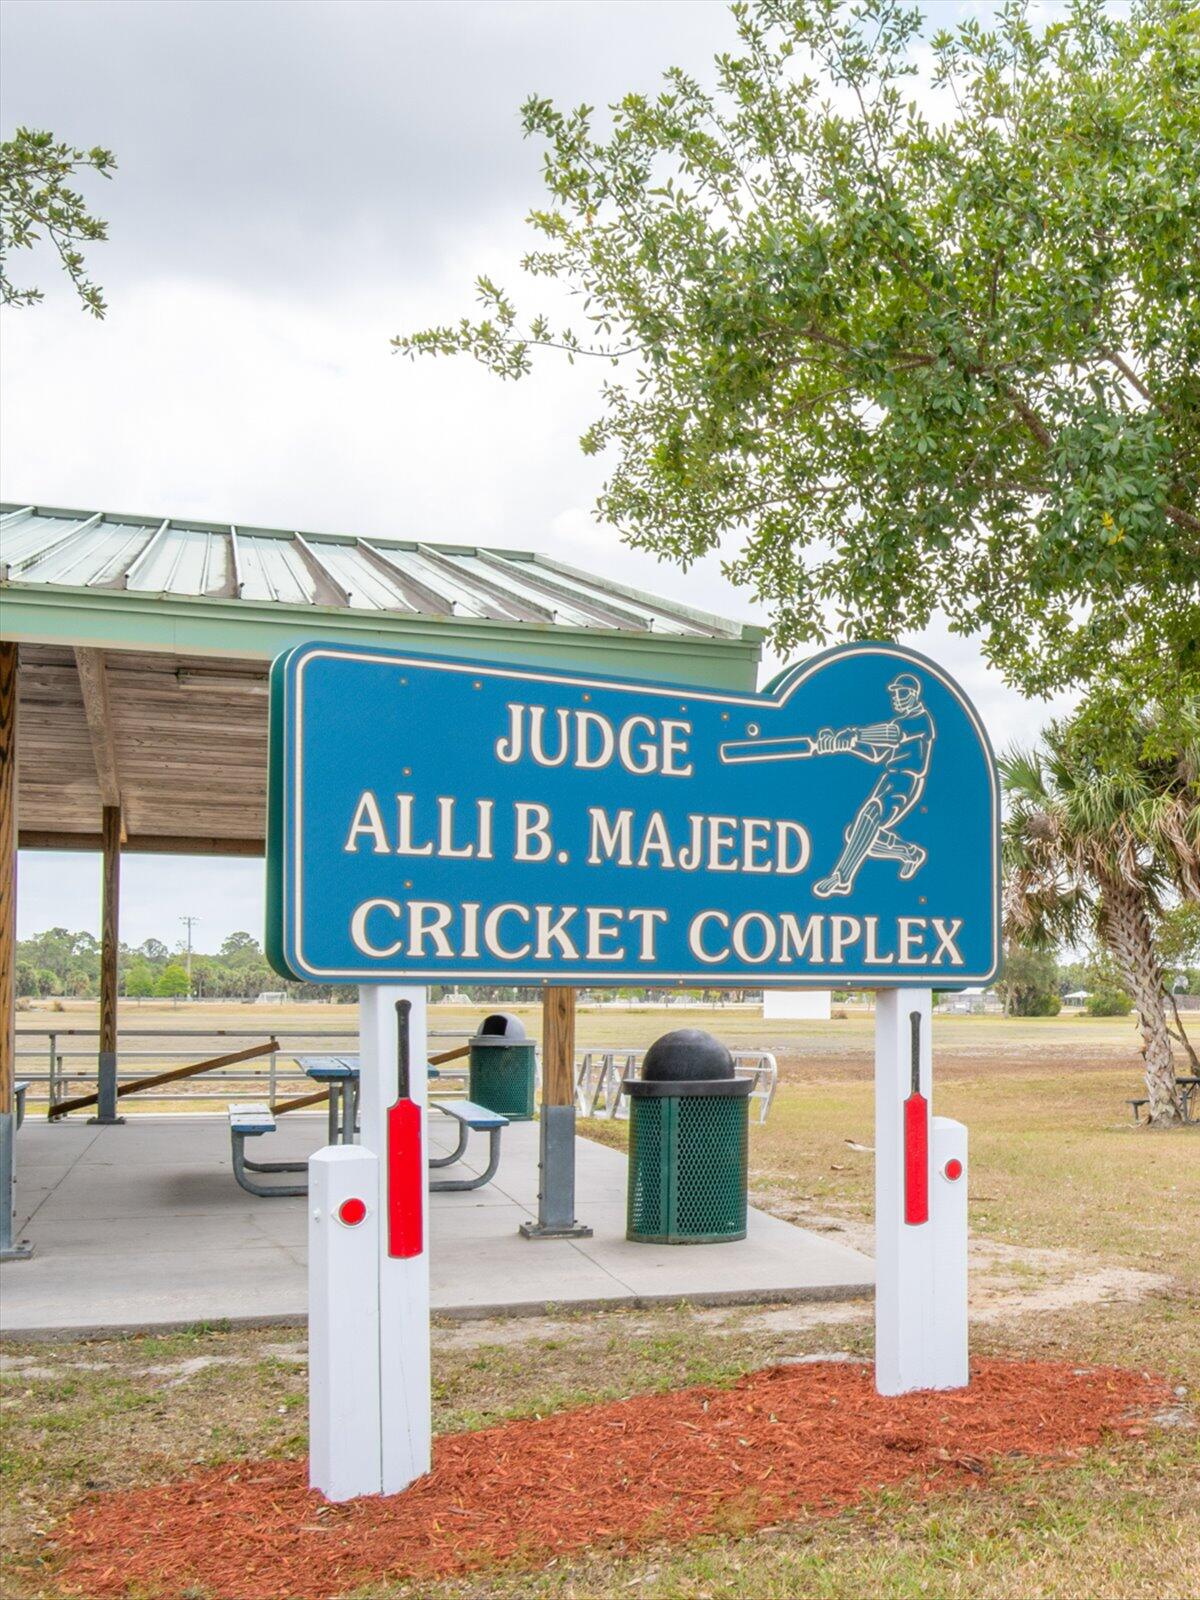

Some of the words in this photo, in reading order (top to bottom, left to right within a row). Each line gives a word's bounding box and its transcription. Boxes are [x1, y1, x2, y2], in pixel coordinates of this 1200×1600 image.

[494, 701, 694, 777] JUDGE
[343, 789, 494, 859] ALLI
[513, 800, 569, 864] B.
[586, 807, 811, 874] MAJEED
[348, 898, 668, 961] CRICKET
[688, 910, 965, 965] COMPLEX
